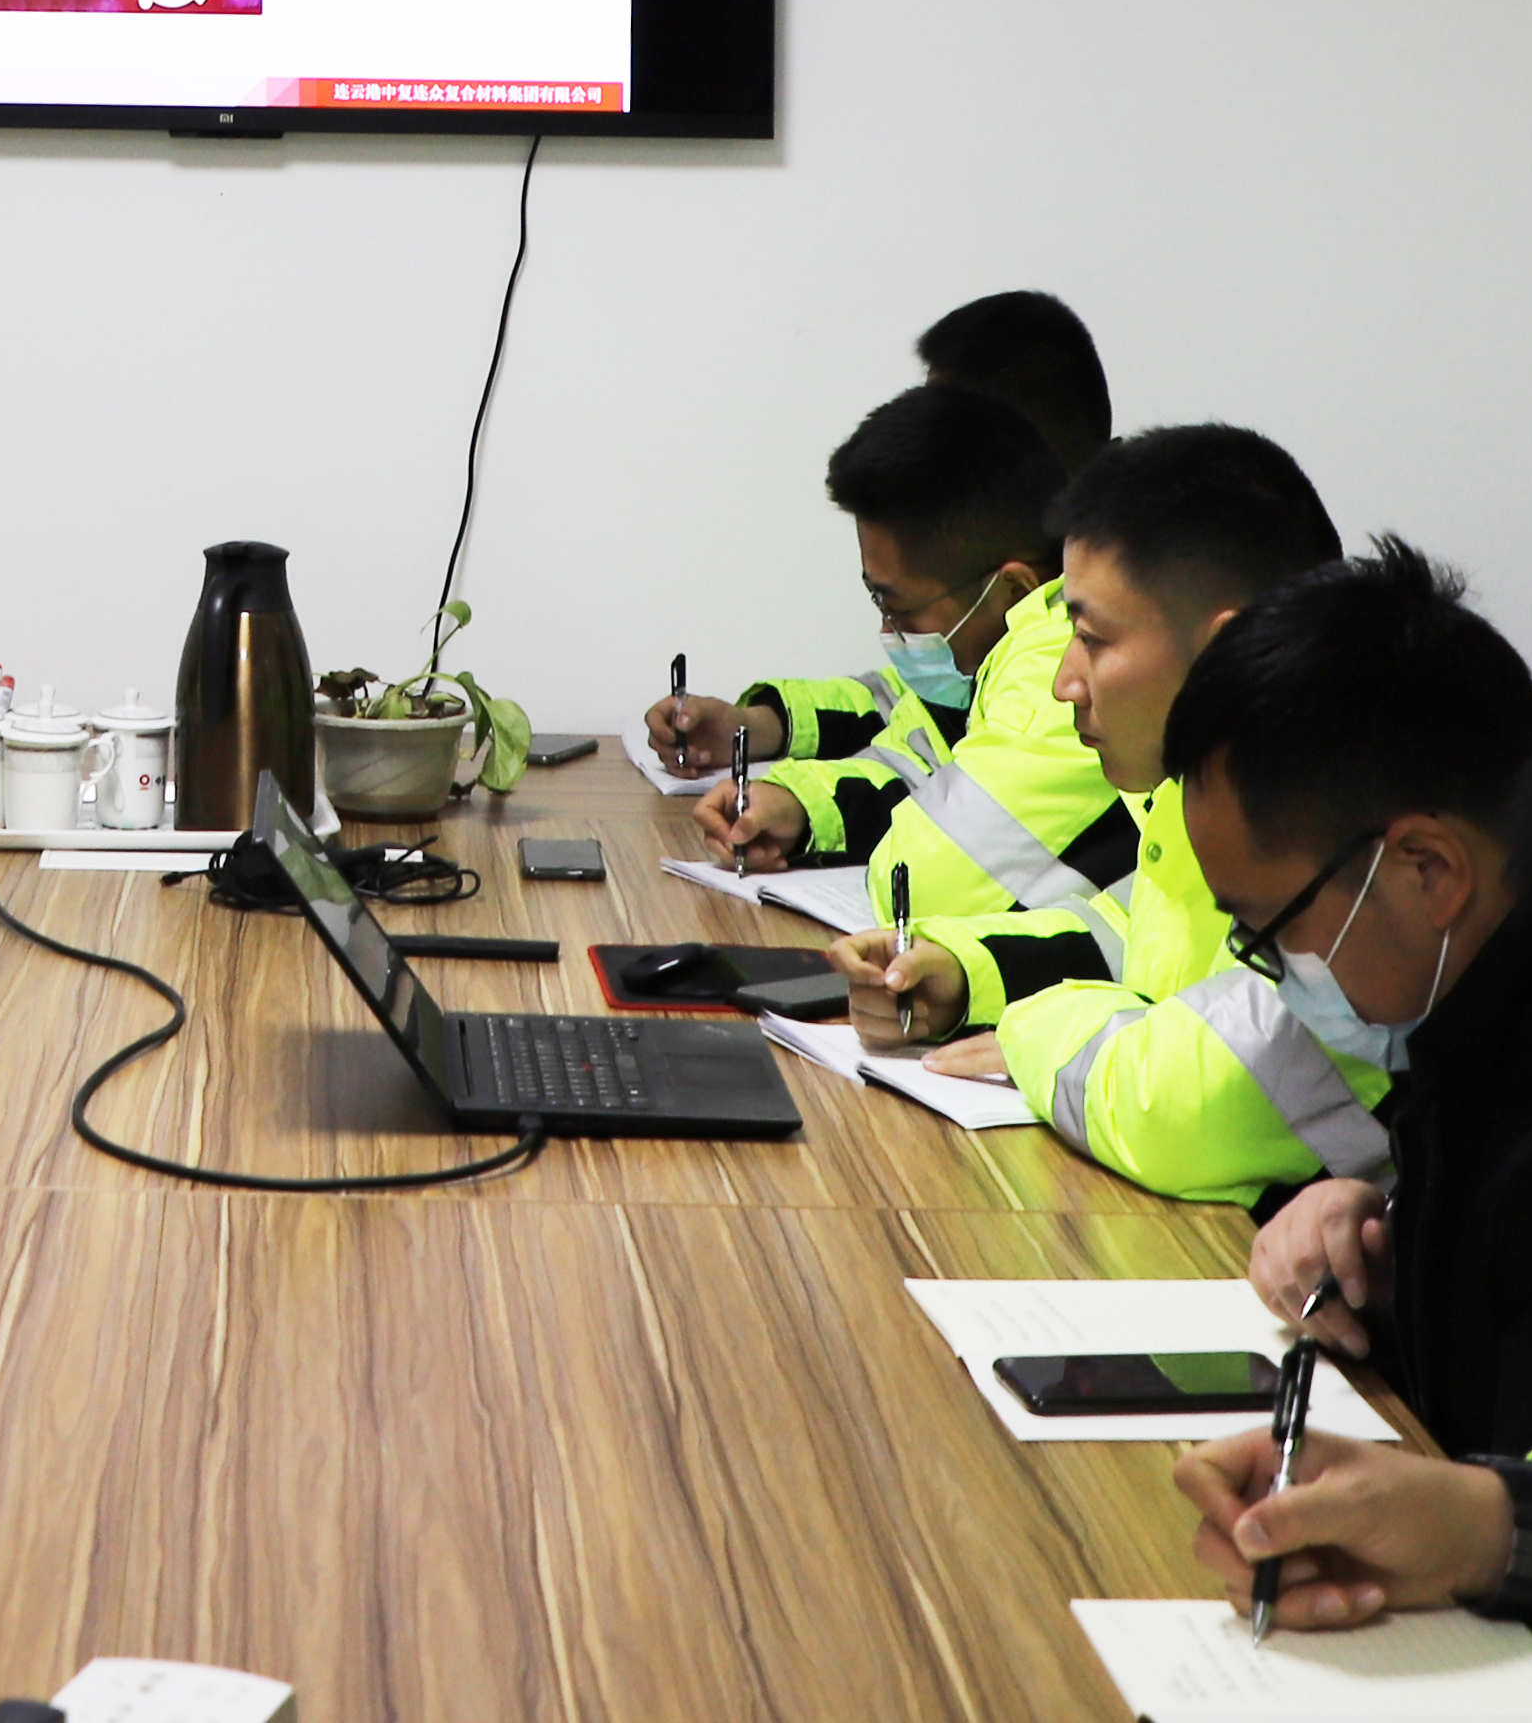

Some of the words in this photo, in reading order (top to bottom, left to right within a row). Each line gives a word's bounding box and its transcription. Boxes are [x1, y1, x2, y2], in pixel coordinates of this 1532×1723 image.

[334, 82, 602, 104] 连云港中复连众复合材料集团有限公司
